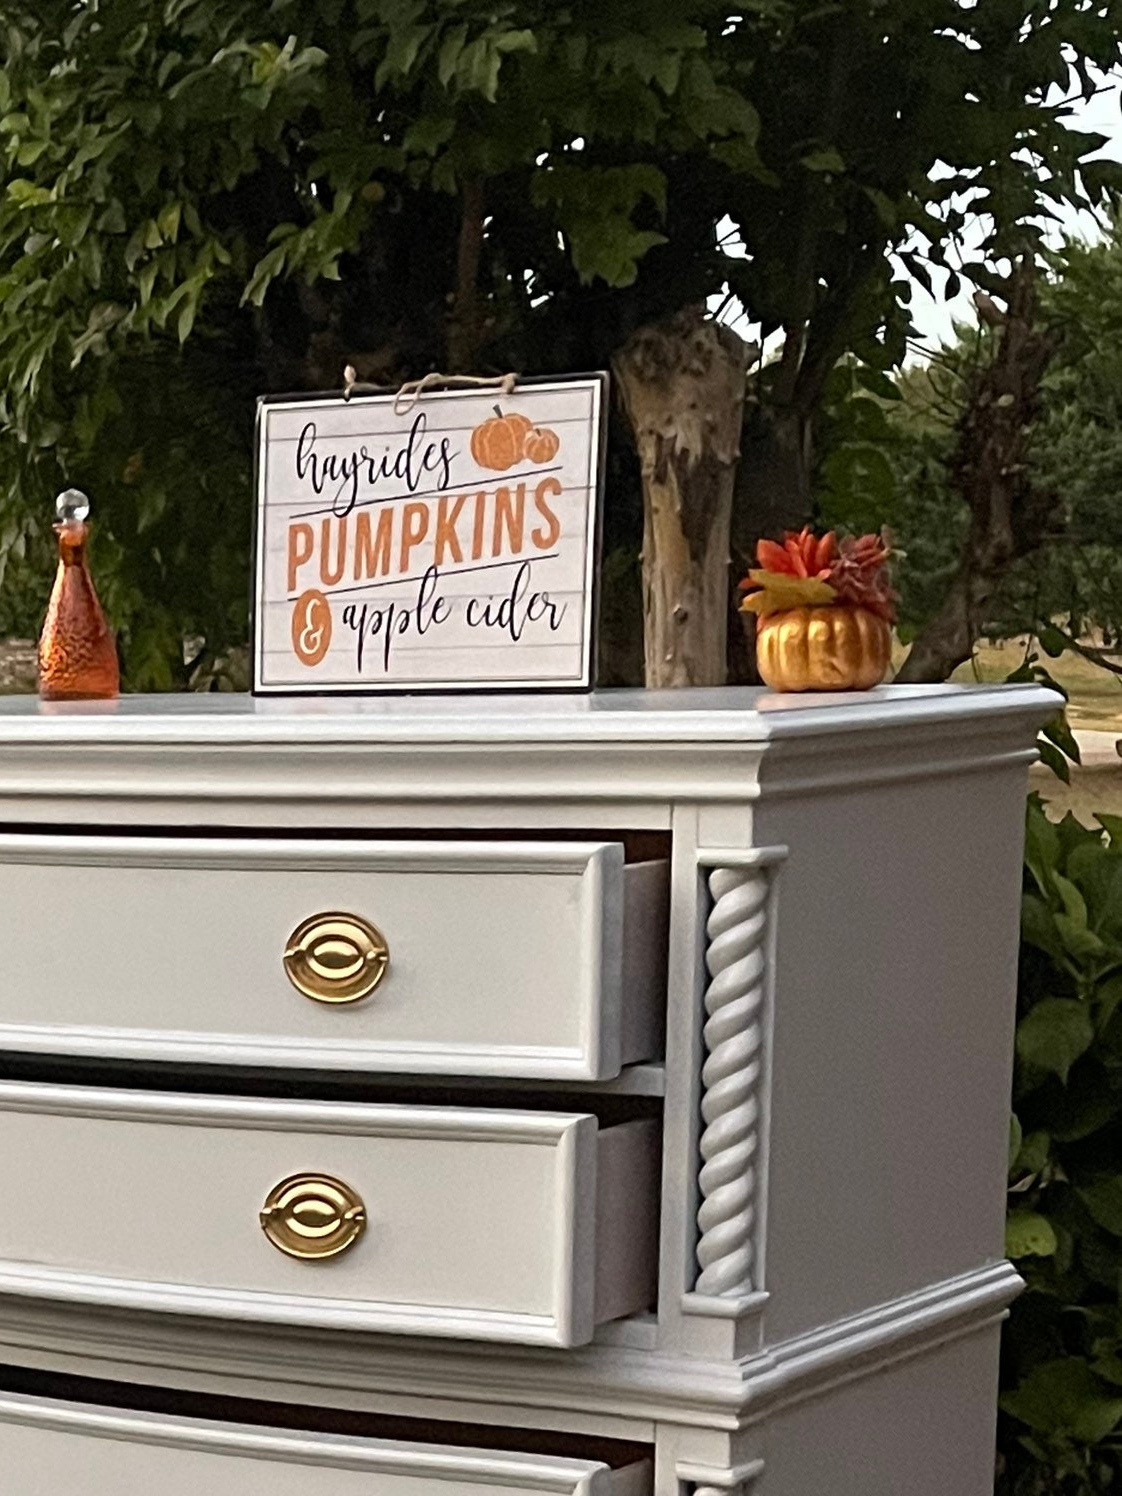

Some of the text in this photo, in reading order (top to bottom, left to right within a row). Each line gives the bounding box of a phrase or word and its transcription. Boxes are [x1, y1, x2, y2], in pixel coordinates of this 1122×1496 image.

[296, 413, 460, 517] hayrides
[287, 477, 562, 591] PUMPKINS
[299, 561, 567, 673] & apple cider
